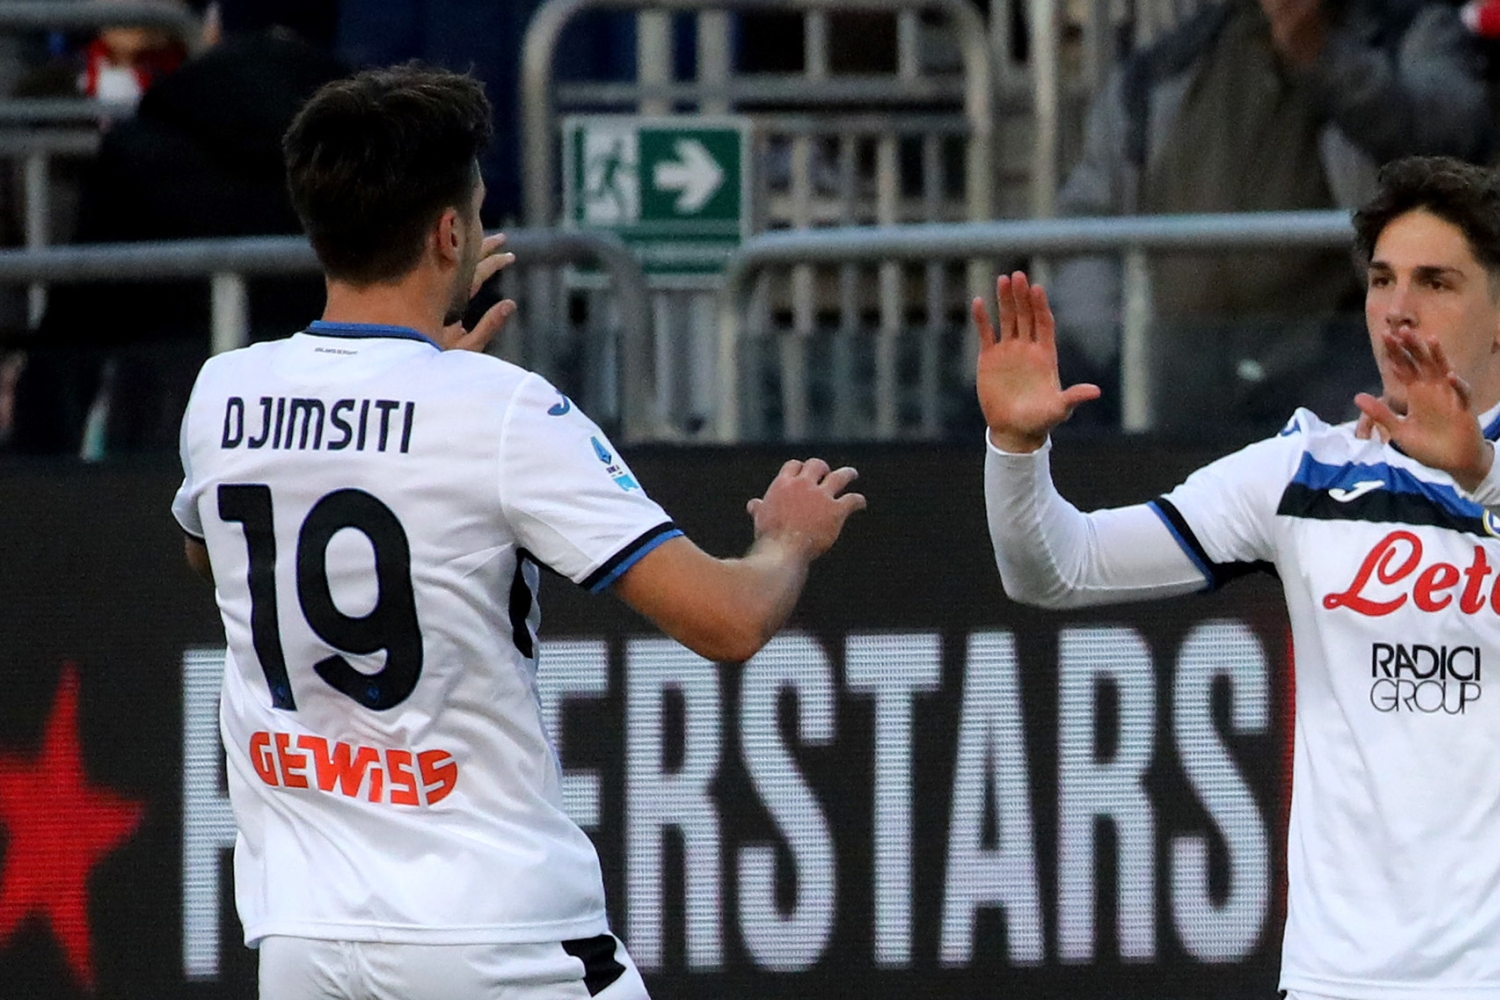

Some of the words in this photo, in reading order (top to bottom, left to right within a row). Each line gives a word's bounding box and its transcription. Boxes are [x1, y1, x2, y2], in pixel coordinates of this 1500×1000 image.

[221, 396, 415, 453] DJIMSITI
[217, 483, 424, 711] 19
[1371, 643, 1481, 681] RADICI
[1370, 678, 1481, 715] GROUP
[249, 731, 458, 806] GEWISS
